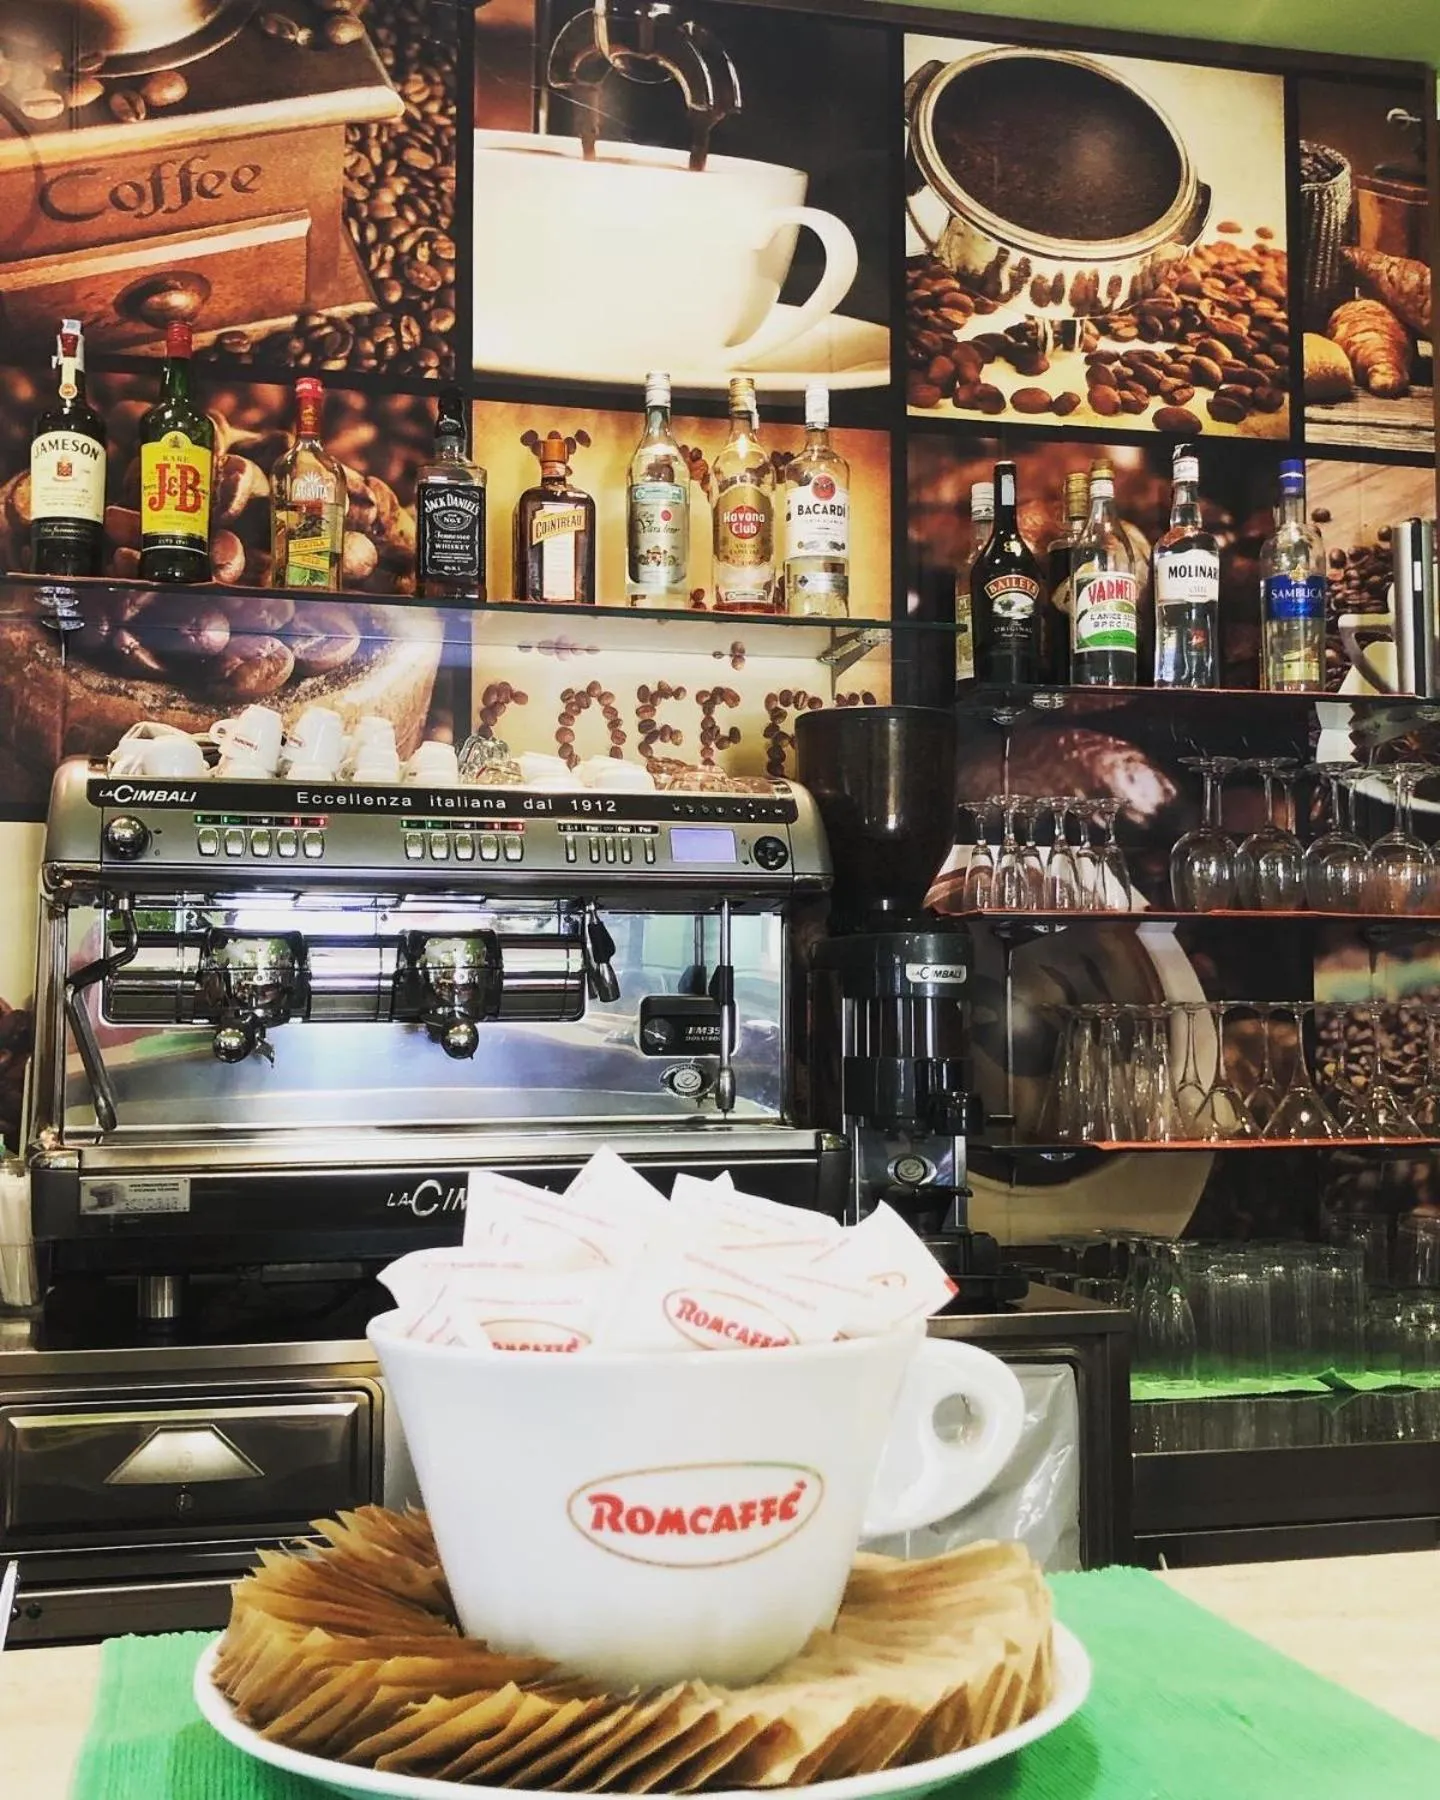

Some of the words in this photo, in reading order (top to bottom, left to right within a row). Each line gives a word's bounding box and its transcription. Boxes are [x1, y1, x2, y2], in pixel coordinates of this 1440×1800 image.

[38, 154, 263, 223] Coffee
[34, 438, 101, 461] JAMESON
[148, 463, 205, 514] J&B
[424, 496, 446, 513] JACK
[535, 514, 583, 539] COINTREAU
[723, 511, 765, 523] Havana
[731, 522, 757, 535] Club
[988, 576, 1037, 594] BAILEYS
[1271, 587, 1323, 600] SAMBUCA
[114, 784, 197, 804] CIMBALI
[296, 791, 412, 807] Eccellenza
[523, 798, 553, 811] dal
[570, 799, 617, 813] 1912
